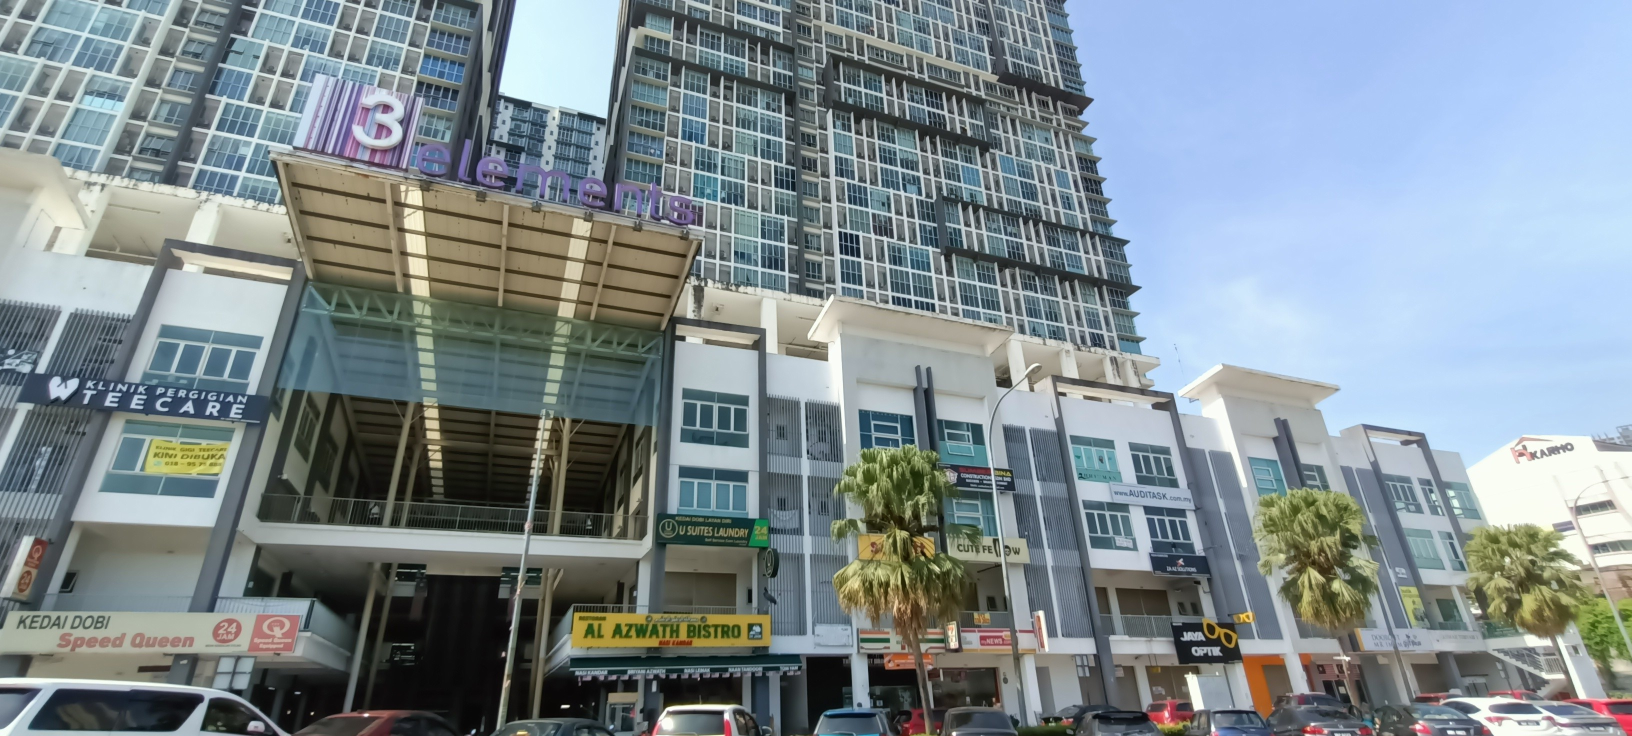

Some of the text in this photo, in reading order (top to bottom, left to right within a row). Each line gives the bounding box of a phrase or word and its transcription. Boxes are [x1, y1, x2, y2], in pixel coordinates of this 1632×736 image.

[352, 93, 404, 150] 3
[416, 139, 696, 226] elements
[85, 380, 248, 404] KLINIK PERGIGIAN
[82, 390, 246, 419] TEECARE
[153, 451, 226, 461] KINI DIBUKA
[1113, 489, 1192, 504] www.AUDITASK.com.my
[679, 525, 749, 538] U SUITES LAUNDRY
[754, 525, 768, 535] 24
[957, 543, 981, 554] CUTE
[16, 614, 111, 630] KEDAI DOBI
[217, 622, 238, 634] 24
[583, 622, 742, 639] AL AZWATH BISTRO
[1180, 631, 1207, 642] JAYA
[56, 632, 195, 652] Speed Queen
[1191, 646, 1223, 657] OPTIK
